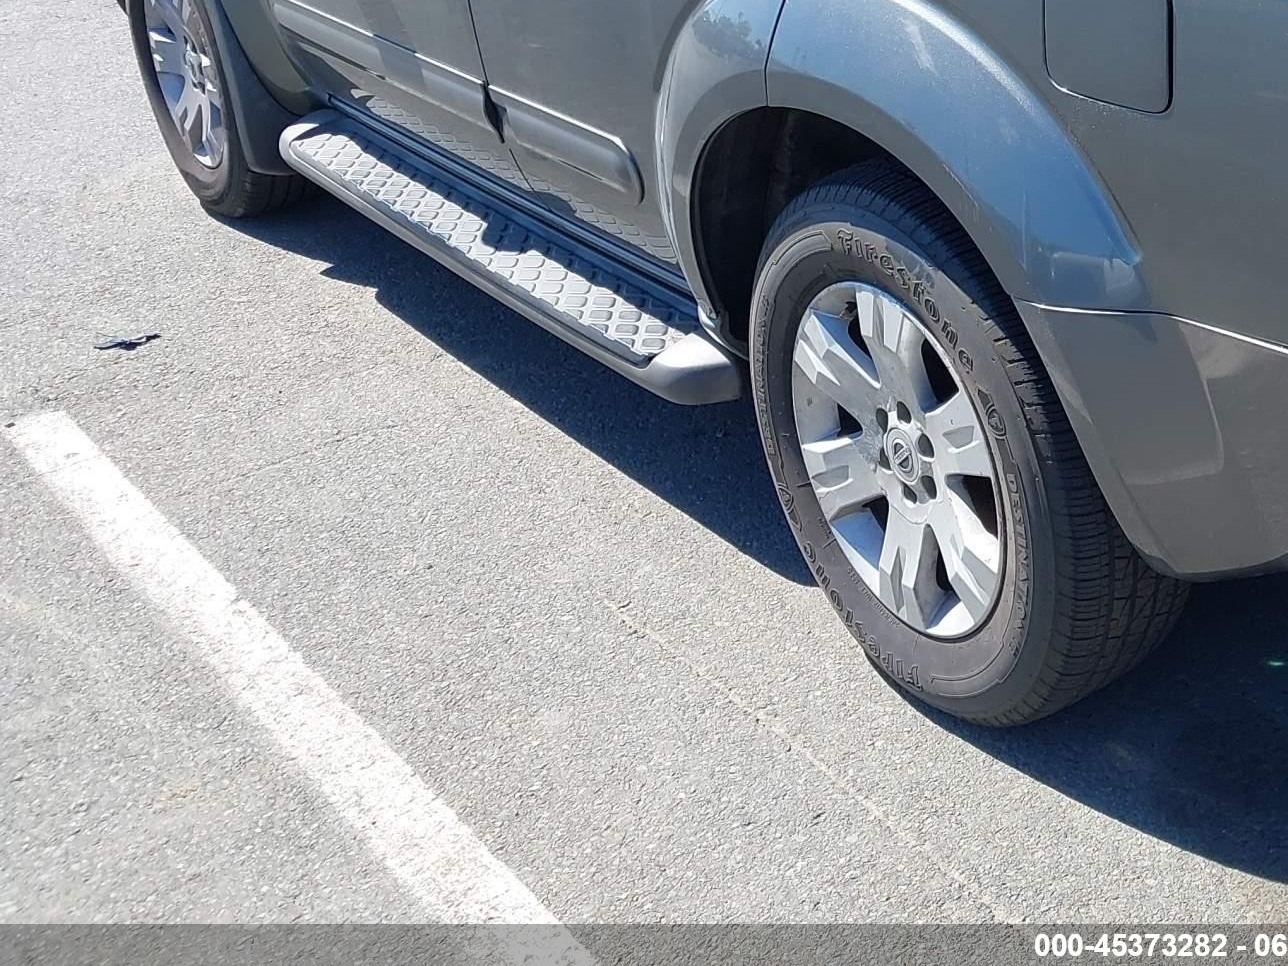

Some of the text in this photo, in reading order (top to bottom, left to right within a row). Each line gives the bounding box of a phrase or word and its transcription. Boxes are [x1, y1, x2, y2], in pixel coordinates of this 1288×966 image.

[837, 227, 974, 373] Firestone
[802, 540, 924, 691] Firestone
[1006, 473, 1030, 632] DESTINATION
